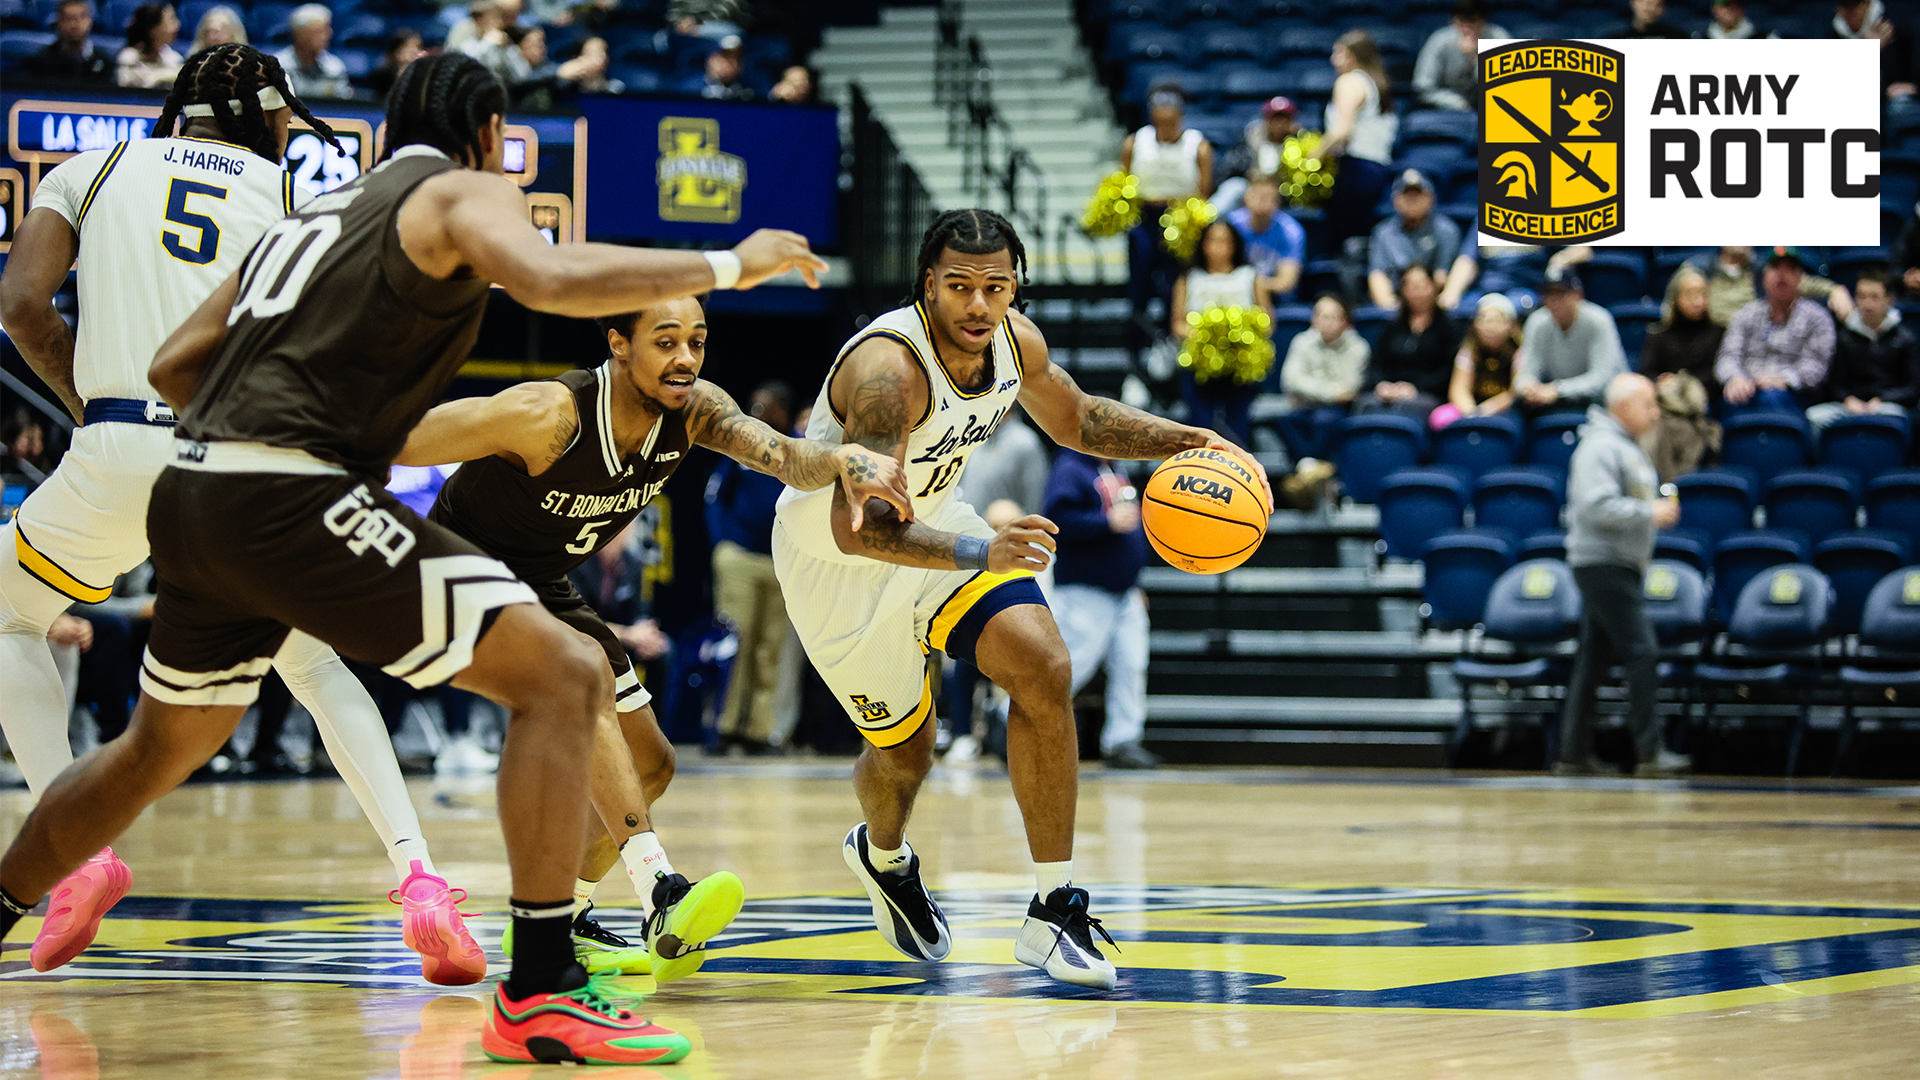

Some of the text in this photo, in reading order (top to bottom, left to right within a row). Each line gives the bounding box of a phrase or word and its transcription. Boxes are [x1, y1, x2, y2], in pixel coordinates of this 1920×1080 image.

[181, 150, 245, 176] HARRIS
[161, 176, 230, 267] 5
[954, 406, 1007, 448] Sall
[915, 455, 964, 498] 10
[1174, 450, 1252, 484] Wilson
[541, 490, 571, 516] ST.
[1171, 474, 1234, 505] NCAA
[565, 520, 612, 555] 5
